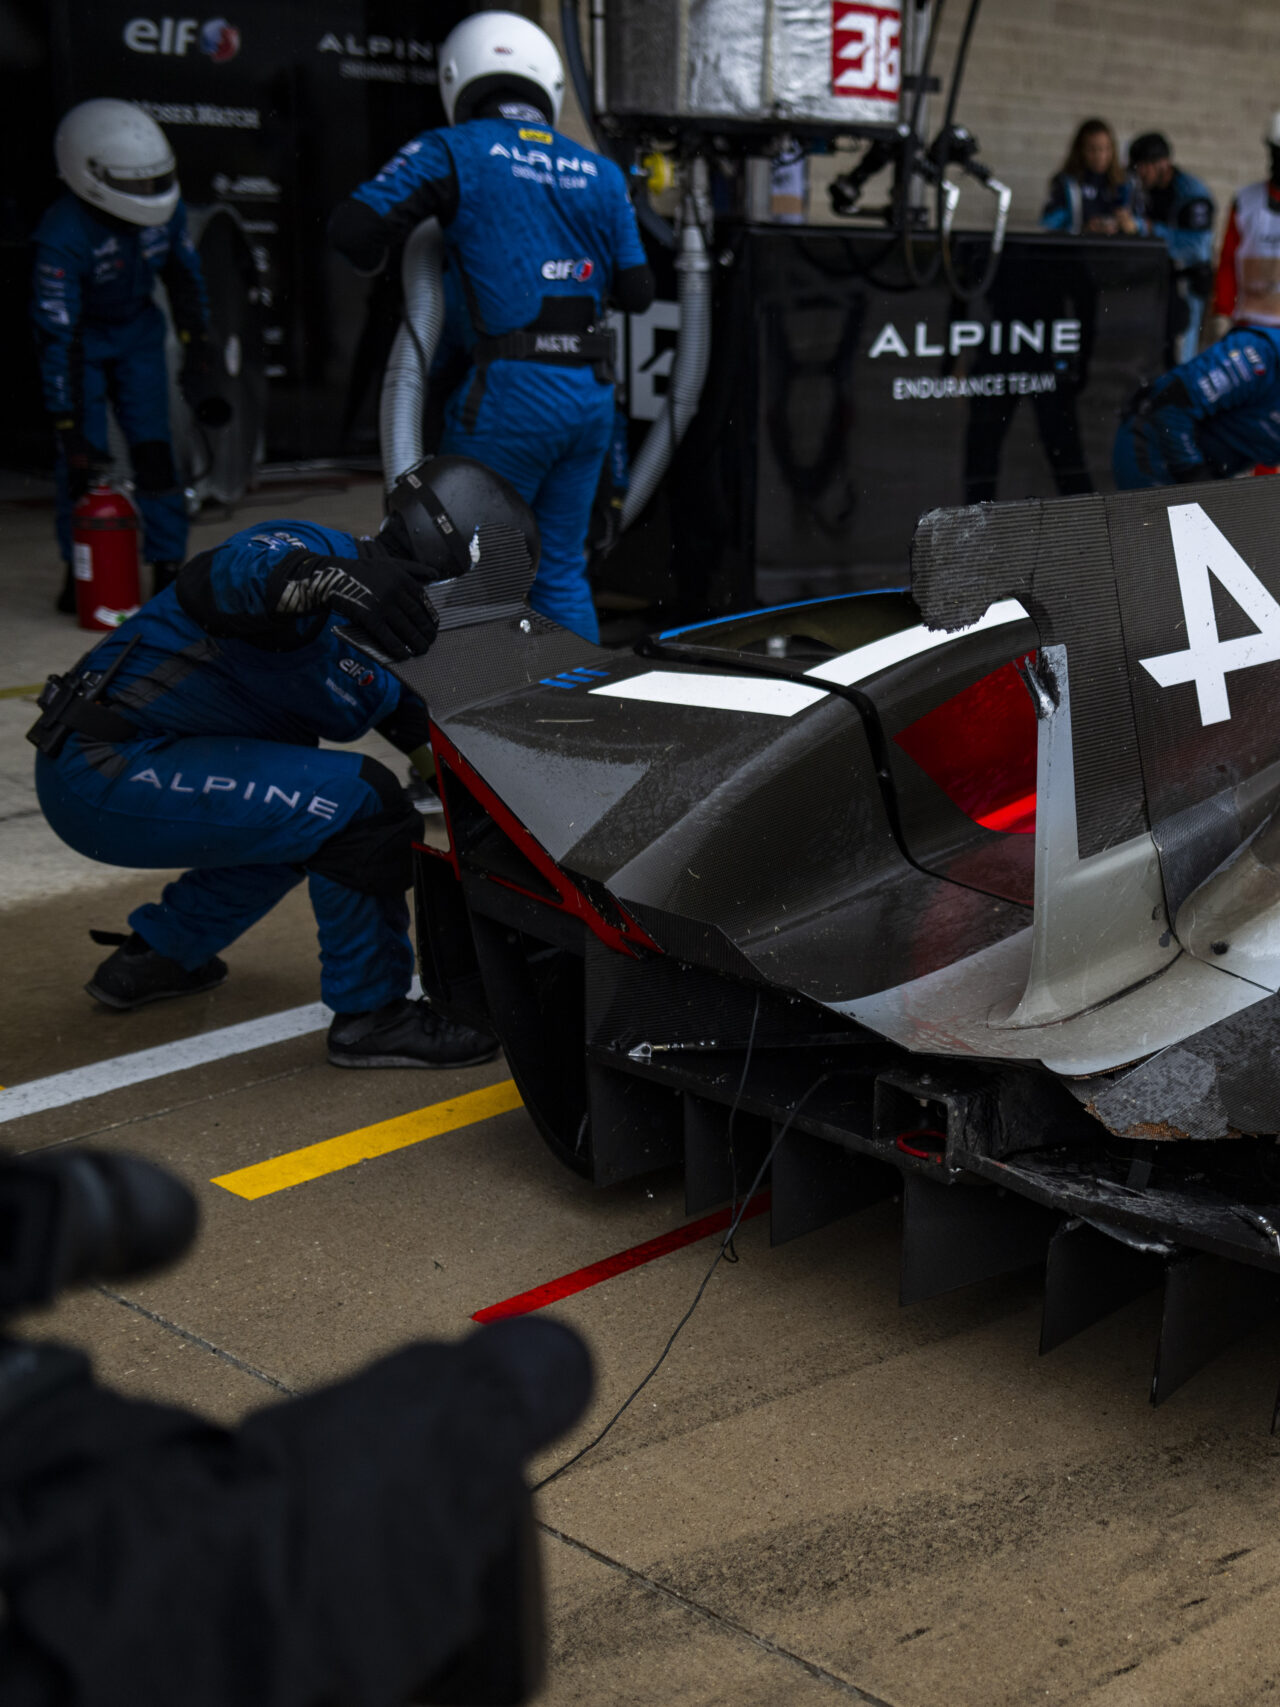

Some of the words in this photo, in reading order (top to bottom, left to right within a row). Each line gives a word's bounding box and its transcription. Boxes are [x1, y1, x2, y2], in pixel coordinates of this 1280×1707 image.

[122, 16, 198, 56] elf
[317, 32, 437, 61] ALPIN
[834, 11, 901, 92] 36
[541, 260, 573, 280] elf
[868, 318, 1082, 358] ALPINE
[893, 374, 1005, 400] ENDURANCE
[1008, 370, 1057, 396] TEAM
[338, 658, 366, 678] elf
[128, 767, 339, 821] ALPINE
